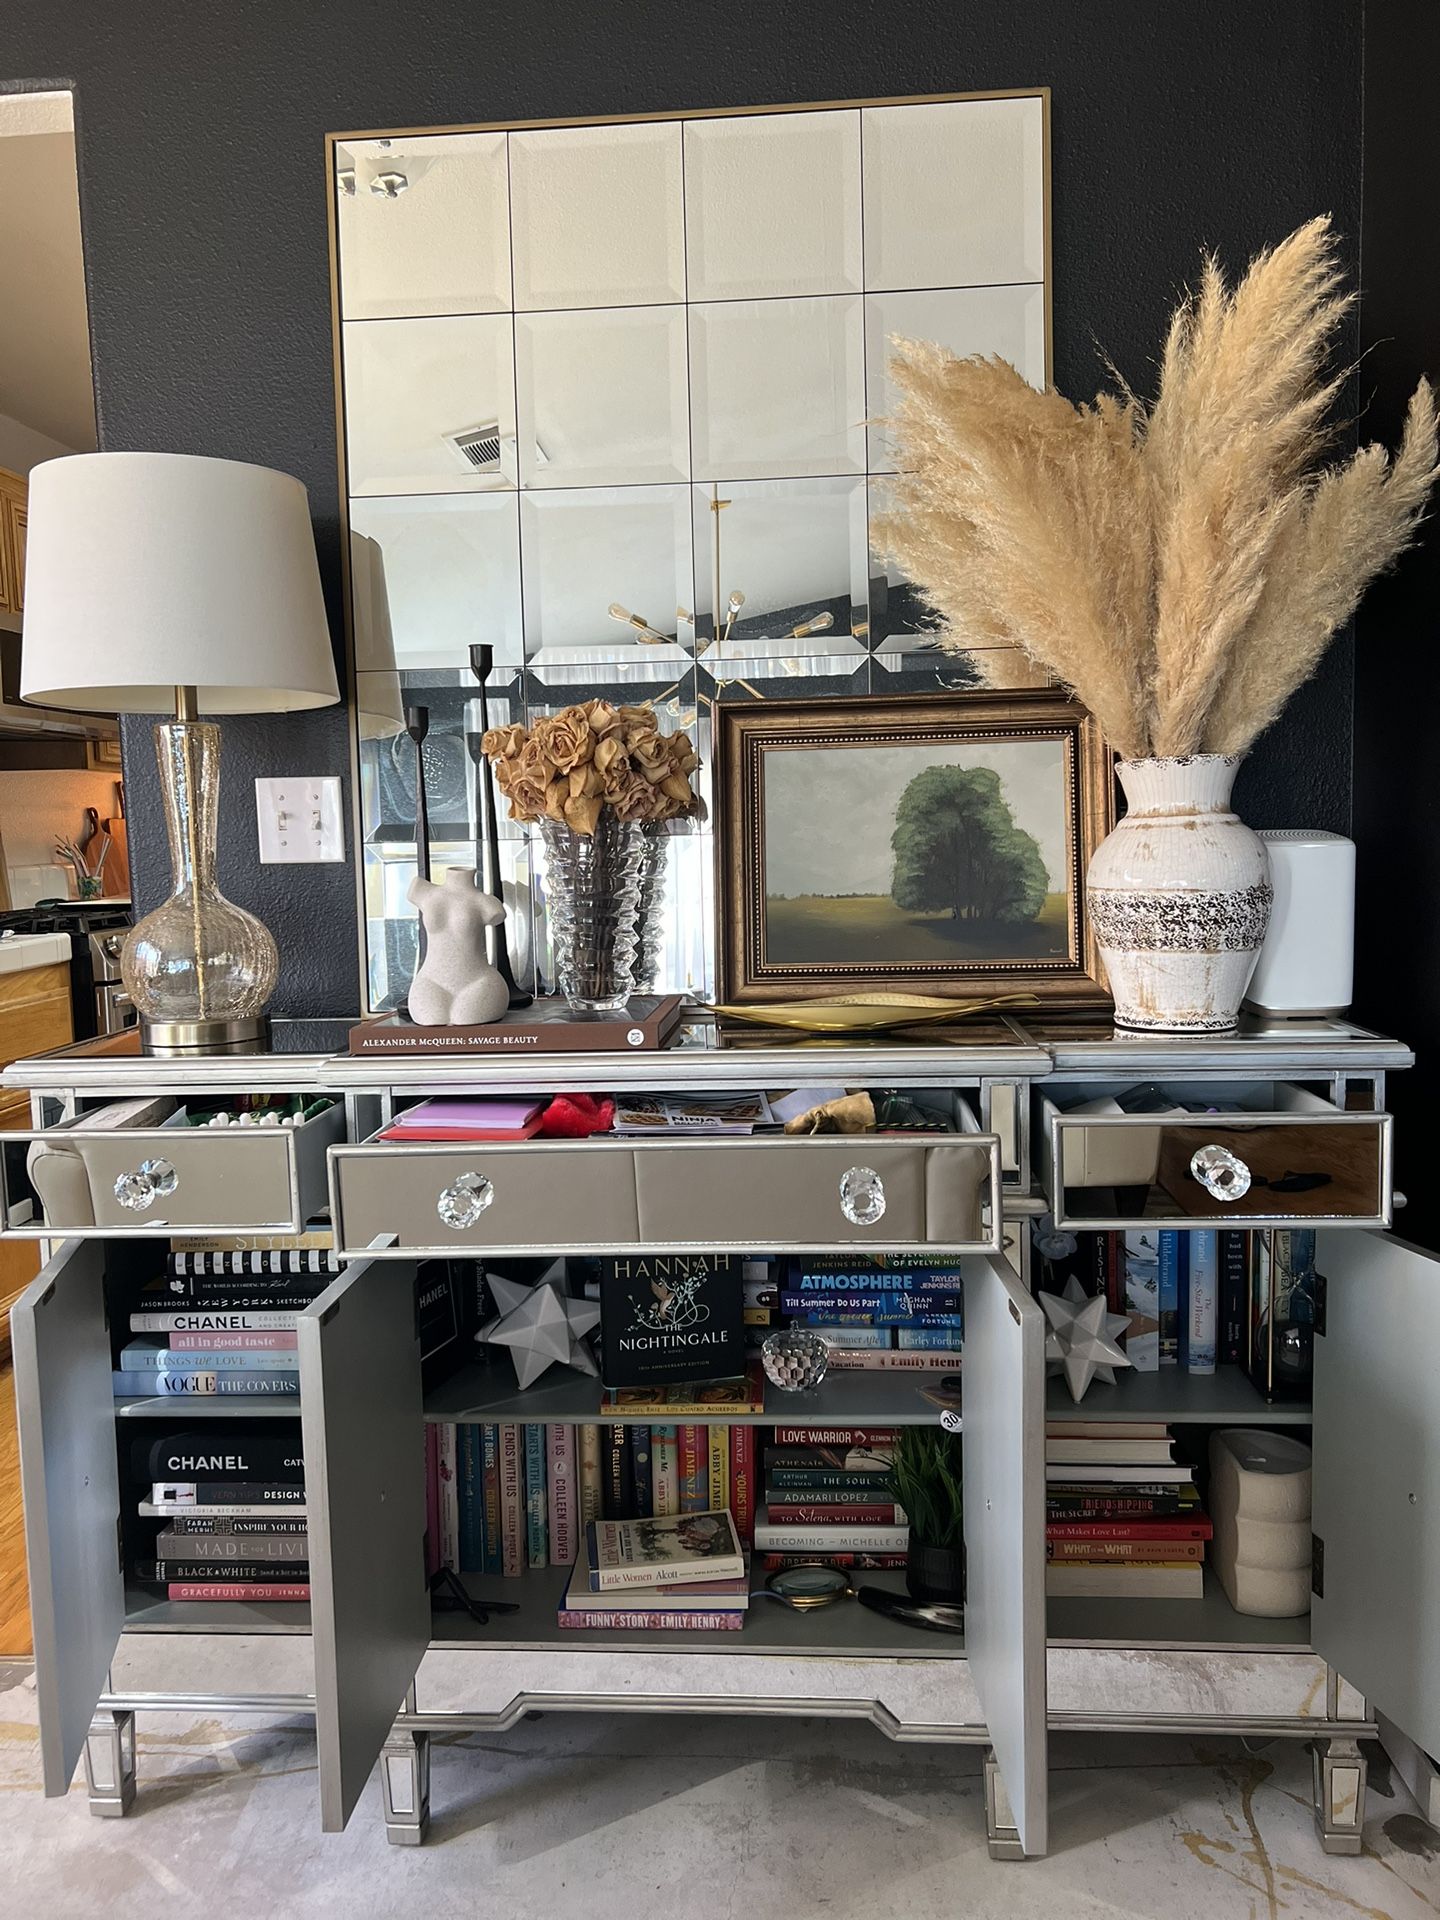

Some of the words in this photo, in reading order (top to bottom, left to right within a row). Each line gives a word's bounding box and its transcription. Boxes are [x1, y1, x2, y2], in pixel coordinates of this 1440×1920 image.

[362, 1038, 417, 1047] ALEXANDER
[418, 1037, 466, 1046] McQUEEN:
[468, 1037, 501, 1045] SAVAGE
[503, 1036, 539, 1045] BEAUTY
[613, 1254, 731, 1279] HANNAH
[813, 1261, 849, 1269] JENKINS
[851, 1260, 872, 1268] REID
[892, 1259, 905, 1267] OF
[907, 1258, 940, 1266] EVELYN
[1161, 1232, 1173, 1288] Hilderbrand
[800, 1274, 913, 1290] ATMOSPHERE
[785, 1298, 799, 1307] Till
[800, 1298, 836, 1308] Summer
[837, 1298, 849, 1307] Do
[850, 1298, 861, 1307] Us
[862, 1298, 880, 1307] Part
[174, 1316, 253, 1330] CHANEL
[664, 1323, 683, 1333] THE
[178, 1336, 195, 1348] all
[197, 1336, 211, 1347] in
[213, 1336, 242, 1349] good
[245, 1335, 276, 1347] taste
[618, 1330, 730, 1352] NIGHTINGALE
[827, 1334, 862, 1345] Summer
[144, 1356, 192, 1366] THINGS
[215, 1355, 247, 1365] LOVE
[163, 1376, 216, 1392] VOGUE
[217, 1380, 247, 1392] THE
[247, 1379, 297, 1392] COVERS
[613, 1424, 625, 1446] EVER
[782, 1430, 807, 1443] LOVE
[808, 1430, 852, 1444] WARRIOR
[505, 1432, 516, 1457] ENDS
[555, 1444, 566, 1456] US
[736, 1427, 745, 1464] JIMENEZ
[484, 1442, 494, 1468] BONES
[711, 1446, 721, 1476] ABBY
[167, 1455, 249, 1471] CHANEL
[612, 1448, 621, 1477] COLLEEN
[506, 1458, 516, 1483] WITH
[529, 1457, 540, 1483] WITH
[685, 1447, 696, 1499] JIMENEZ
[823, 1476, 841, 1485] THE
[846, 1476, 872, 1485] SOUL
[263, 1490, 300, 1499] DESIGN
[507, 1485, 517, 1498] US
[530, 1483, 541, 1496] US
[737, 1473, 747, 1503] YOURS
[555, 1478, 567, 1520] COLLEEN
[784, 1493, 832, 1502] ADAMARI
[1080, 1498, 1154, 1510] FRIENDSHIPPING
[486, 1488, 496, 1523] COLLEEN
[508, 1505, 516, 1532] COLLEEN
[736, 1503, 747, 1533] TRULY
[1050, 1510, 1067, 1519] THE
[1069, 1508, 1097, 1518] SECRET
[187, 1519, 214, 1527] FARAH
[234, 1522, 269, 1532] INSPIRE
[271, 1522, 297, 1532] YOUR
[1066, 1527, 1091, 1536] Makes
[1092, 1527, 1111, 1536] Love
[556, 1522, 569, 1560] HOOVER
[769, 1538, 825, 1547] BECOMING
[839, 1538, 890, 1547] MICHELLE
[195, 1542, 249, 1556] MADE
[267, 1541, 304, 1556] LIVI
[1063, 1543, 1090, 1555] WHAT
[1105, 1543, 1133, 1555] WHAT
[177, 1567, 214, 1577] BLACK
[220, 1567, 258, 1577] WHITE
[601, 1573, 621, 1585] Little
[622, 1572, 653, 1584] Women
[655, 1569, 678, 1581] Alcott
[181, 1587, 246, 1597] GRACEFULLY
[250, 1587, 272, 1597] YOU
[278, 1589, 305, 1597] JENNA
[585, 1614, 616, 1628] FUNNY
[618, 1613, 650, 1627] STORY
[660, 1613, 689, 1628] EMILY
[690, 1613, 721, 1629] HENRY
